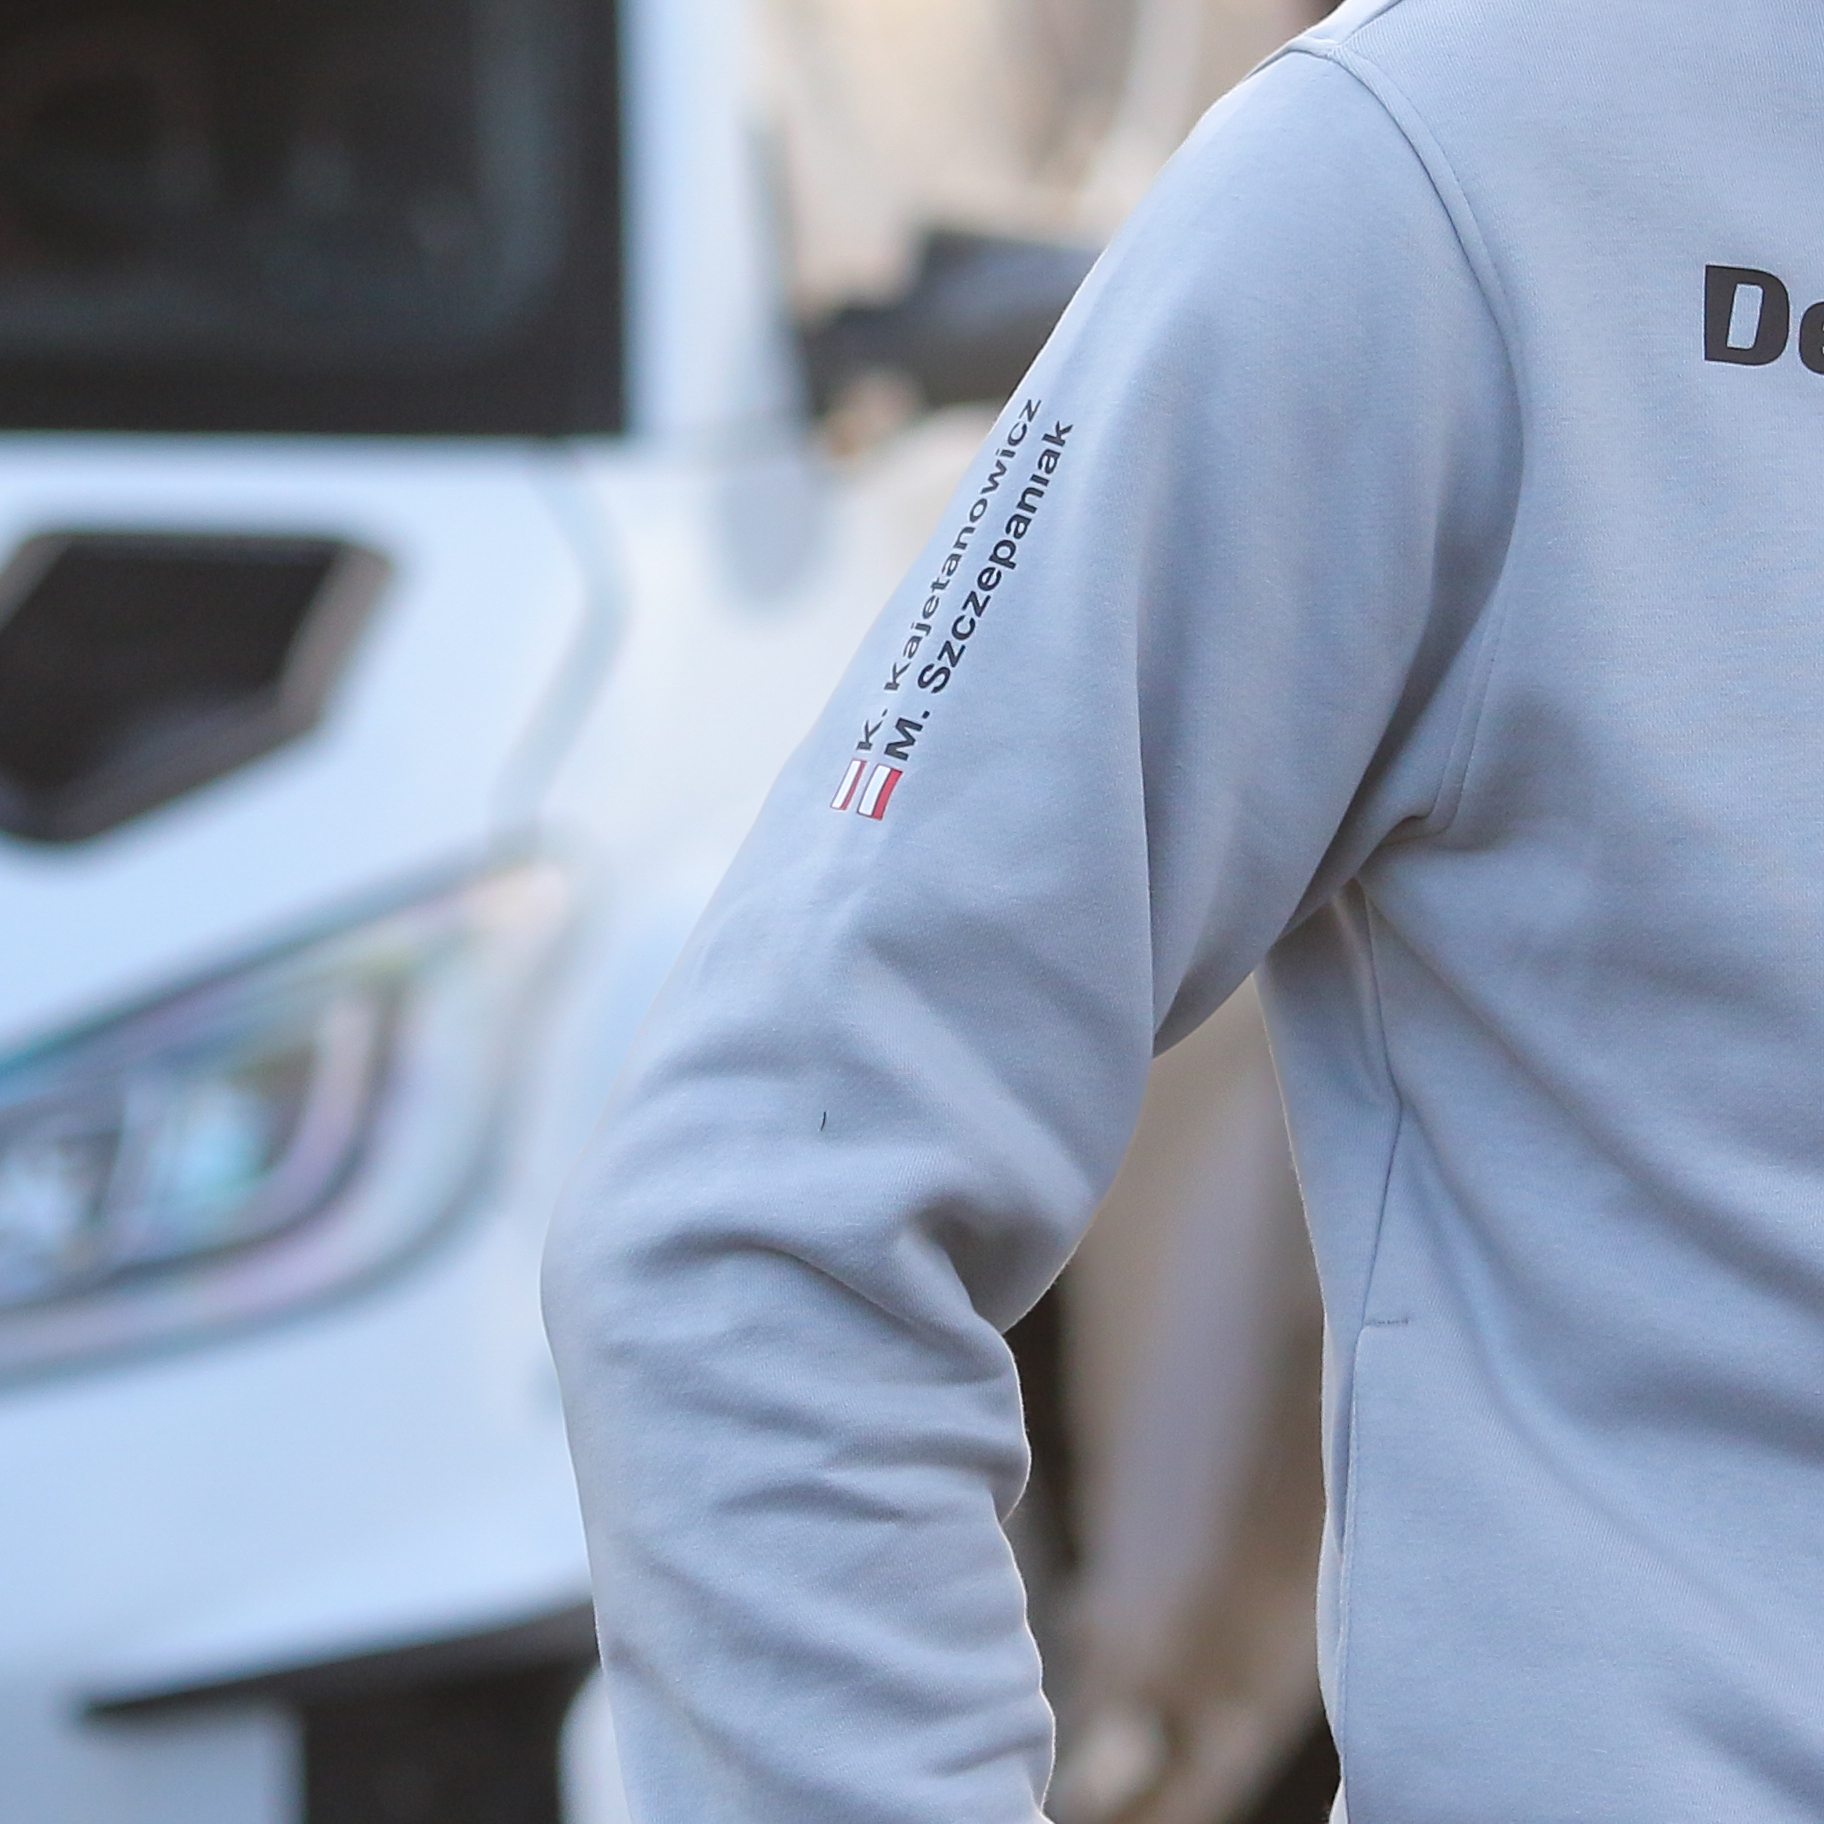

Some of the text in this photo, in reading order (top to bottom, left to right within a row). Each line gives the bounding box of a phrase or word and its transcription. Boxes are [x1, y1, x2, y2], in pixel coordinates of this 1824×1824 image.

[856, 399, 1042, 751] K. Kajetanowicz
[884, 421, 1074, 761] M. Szczepaniak
